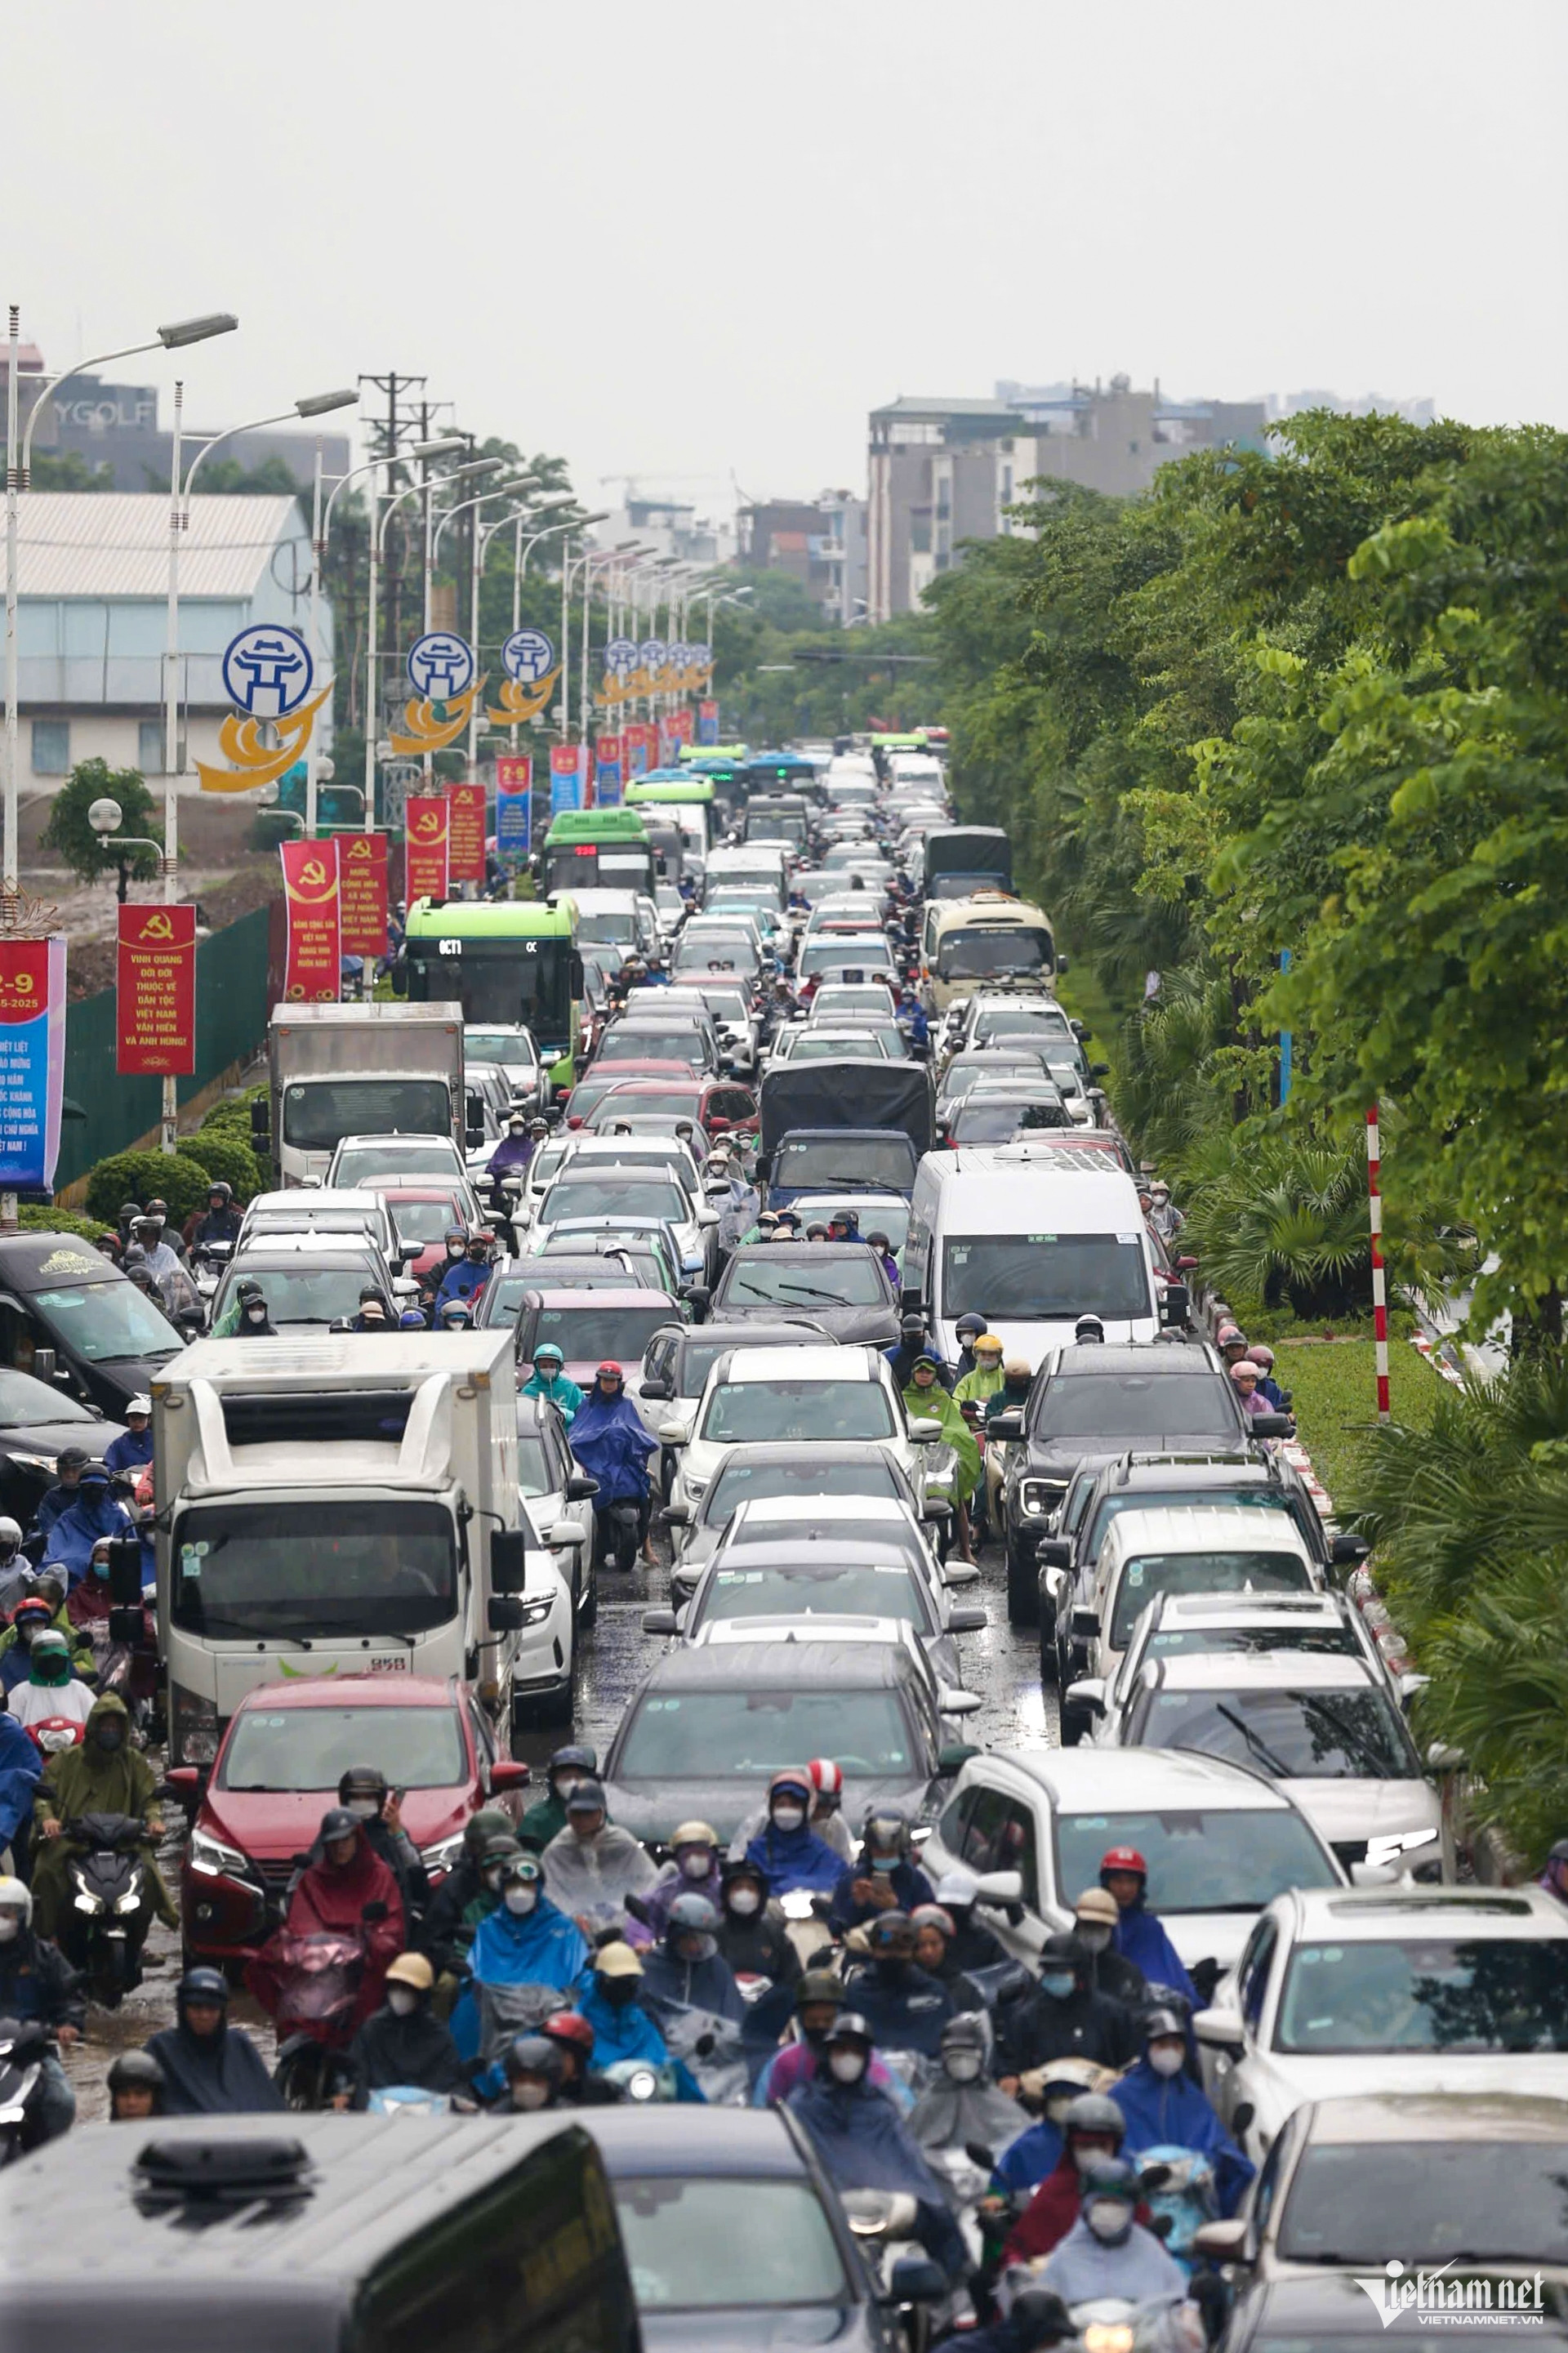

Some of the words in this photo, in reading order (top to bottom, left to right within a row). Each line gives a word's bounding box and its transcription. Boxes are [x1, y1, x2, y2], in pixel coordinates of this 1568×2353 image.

[131, 955, 151, 964] VINH
[154, 955, 182, 965] QUANG
[0, 974, 33, 993] -9
[136, 982, 163, 992] THUỘC
[0, 998, 38, 1008] 5-2025
[136, 1009, 154, 1020] VIỆT
[156, 1009, 176, 1018] NAM
[139, 1036, 158, 1045] ANH
[7, 1138, 23, 1151] NAM
